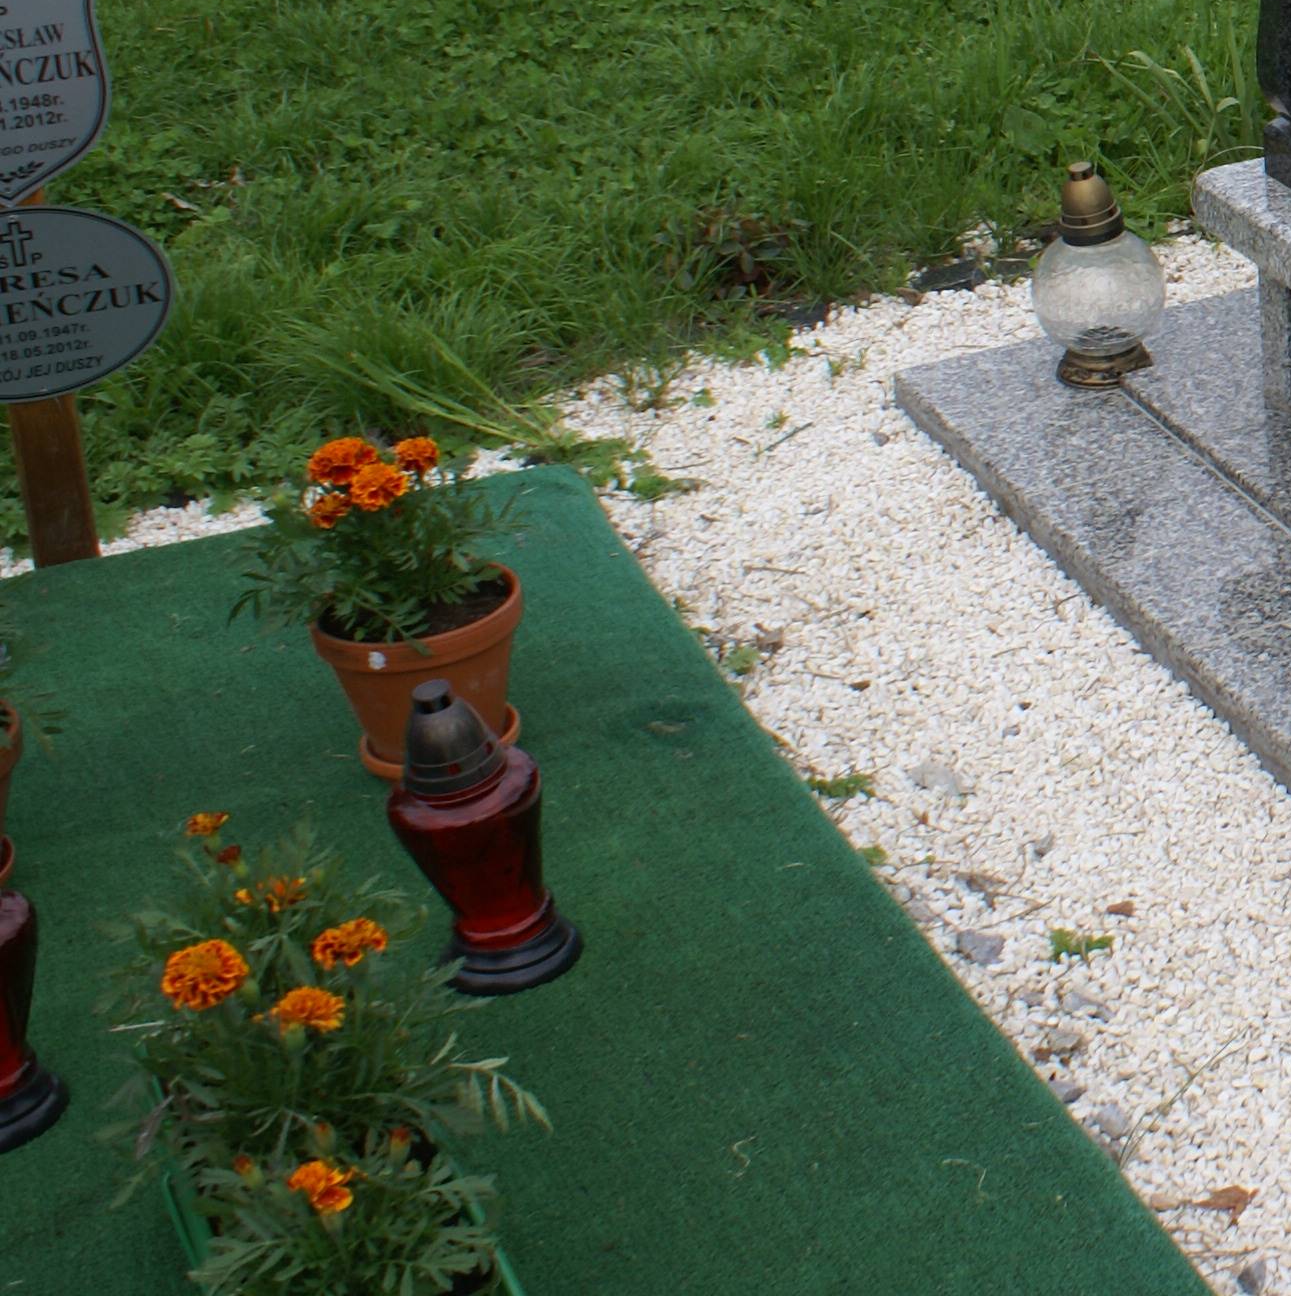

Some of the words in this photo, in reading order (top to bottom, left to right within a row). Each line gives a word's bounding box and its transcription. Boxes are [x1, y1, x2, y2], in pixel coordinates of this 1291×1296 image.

[28, 137, 77, 153] DUSZY
[31, 252, 43, 265] P
[0, 281, 162, 326] EŃCZUK
[26, 364, 52, 379] JEJ
[55, 355, 103, 374] DUSZY
